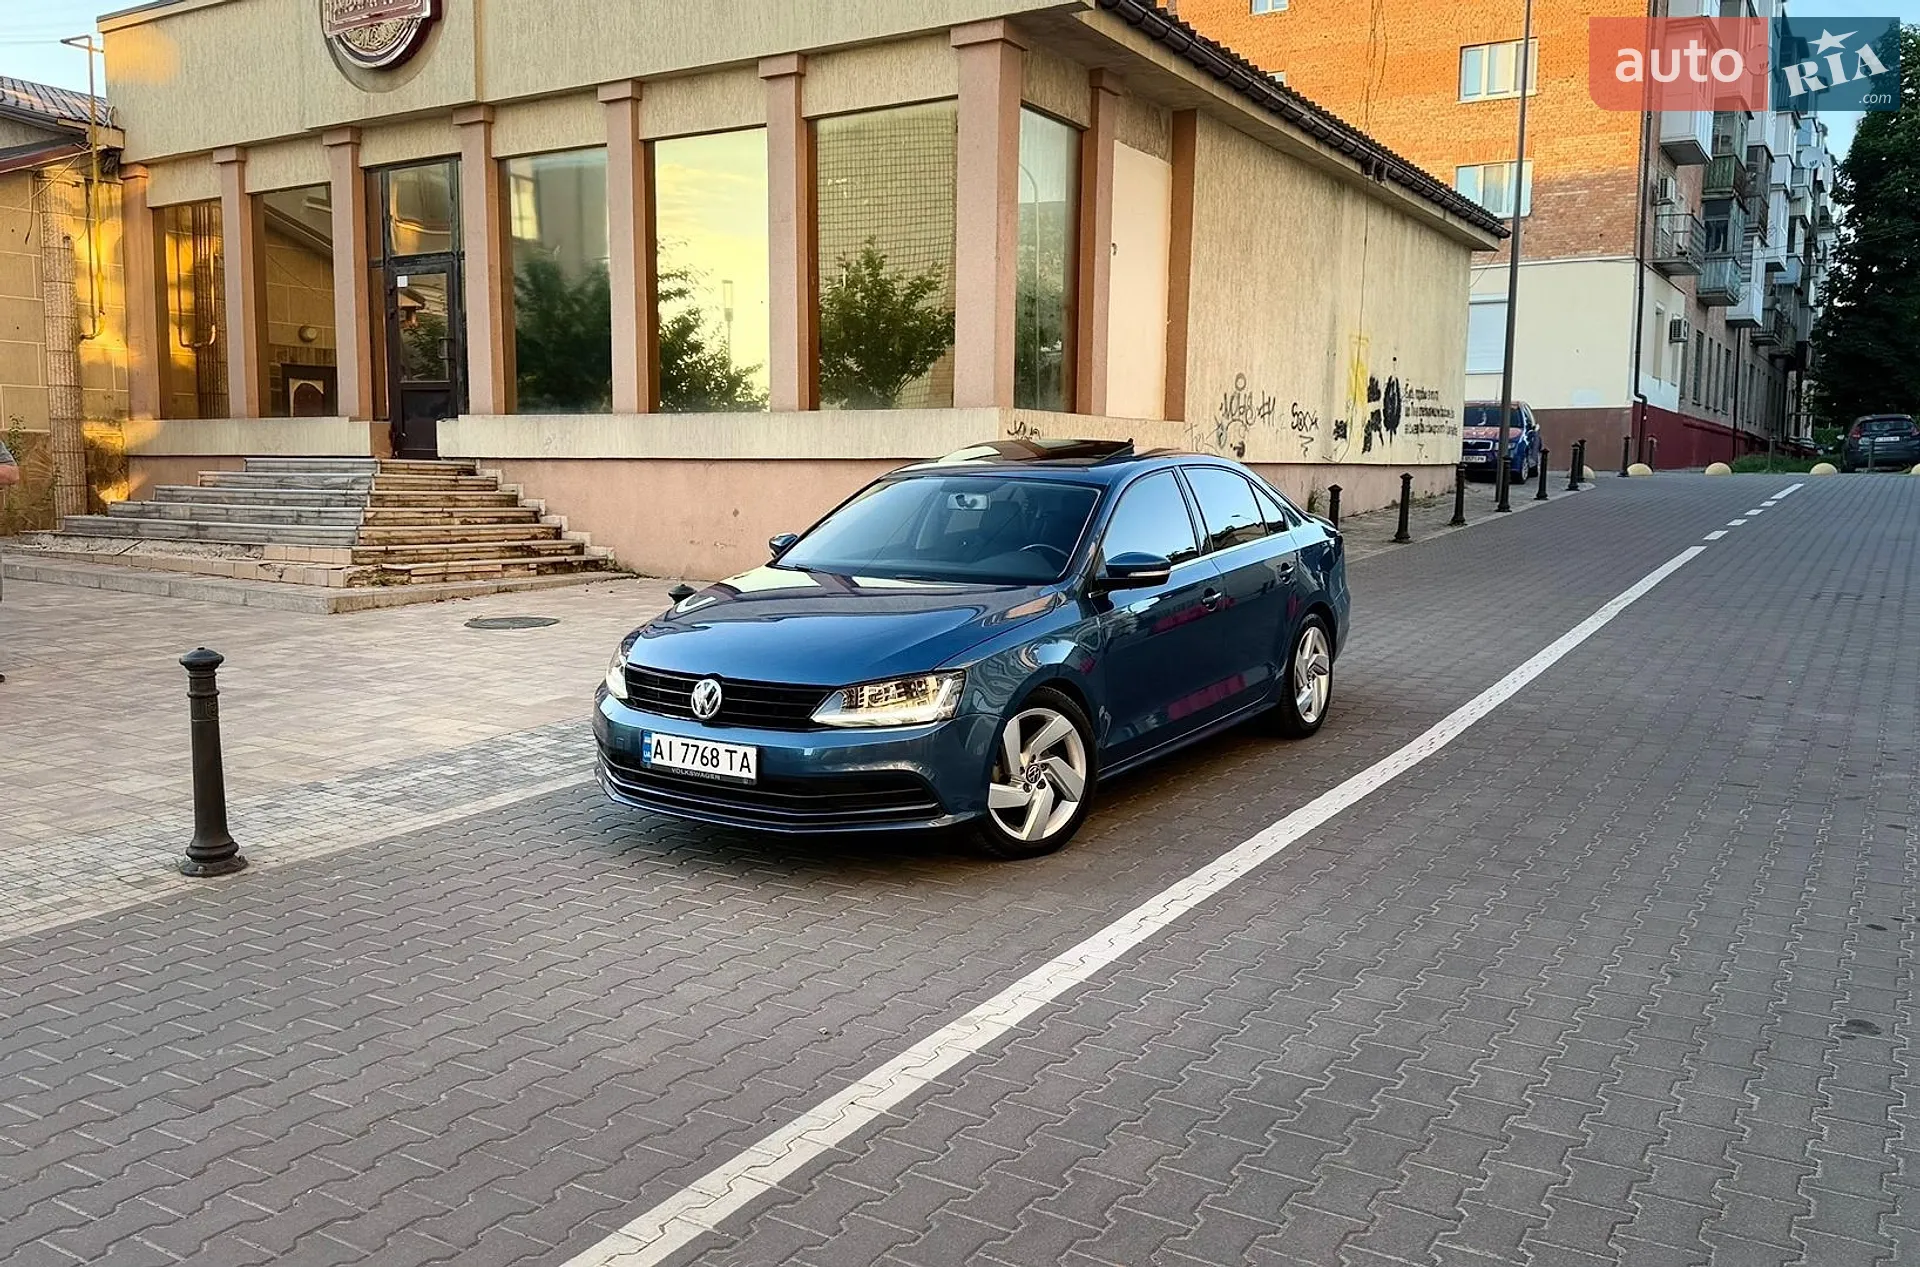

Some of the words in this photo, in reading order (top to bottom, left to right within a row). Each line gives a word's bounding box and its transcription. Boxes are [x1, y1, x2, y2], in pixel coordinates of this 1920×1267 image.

[653, 739, 673, 762] AI
[681, 743, 720, 768] 7768
[724, 749, 752, 774] TA
[671, 767, 721, 780] VOLKSWAGEN
